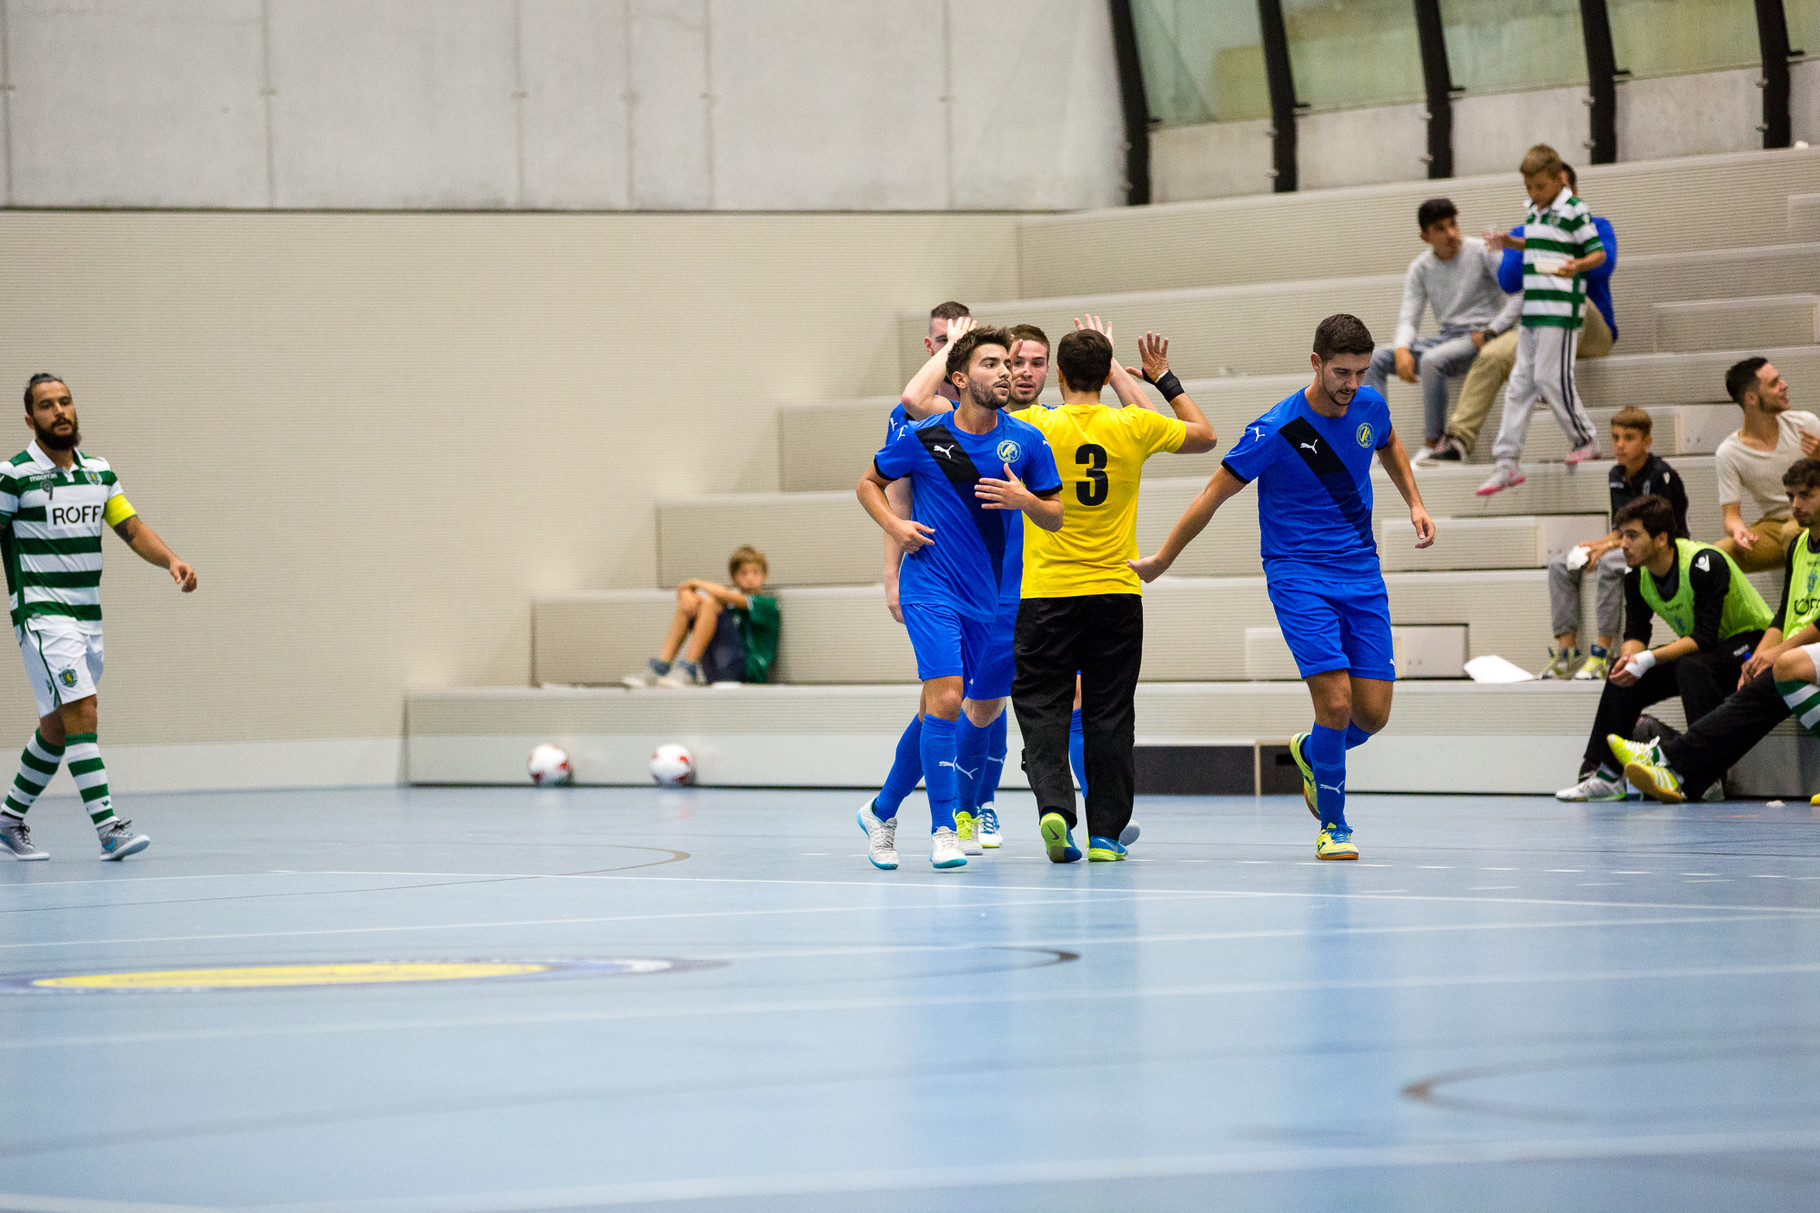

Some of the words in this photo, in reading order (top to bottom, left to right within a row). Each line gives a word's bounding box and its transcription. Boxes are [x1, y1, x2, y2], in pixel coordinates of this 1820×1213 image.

[1075, 444, 1109, 506] 3
[41, 479, 53, 501] 9
[52, 505, 101, 525] ROFF
